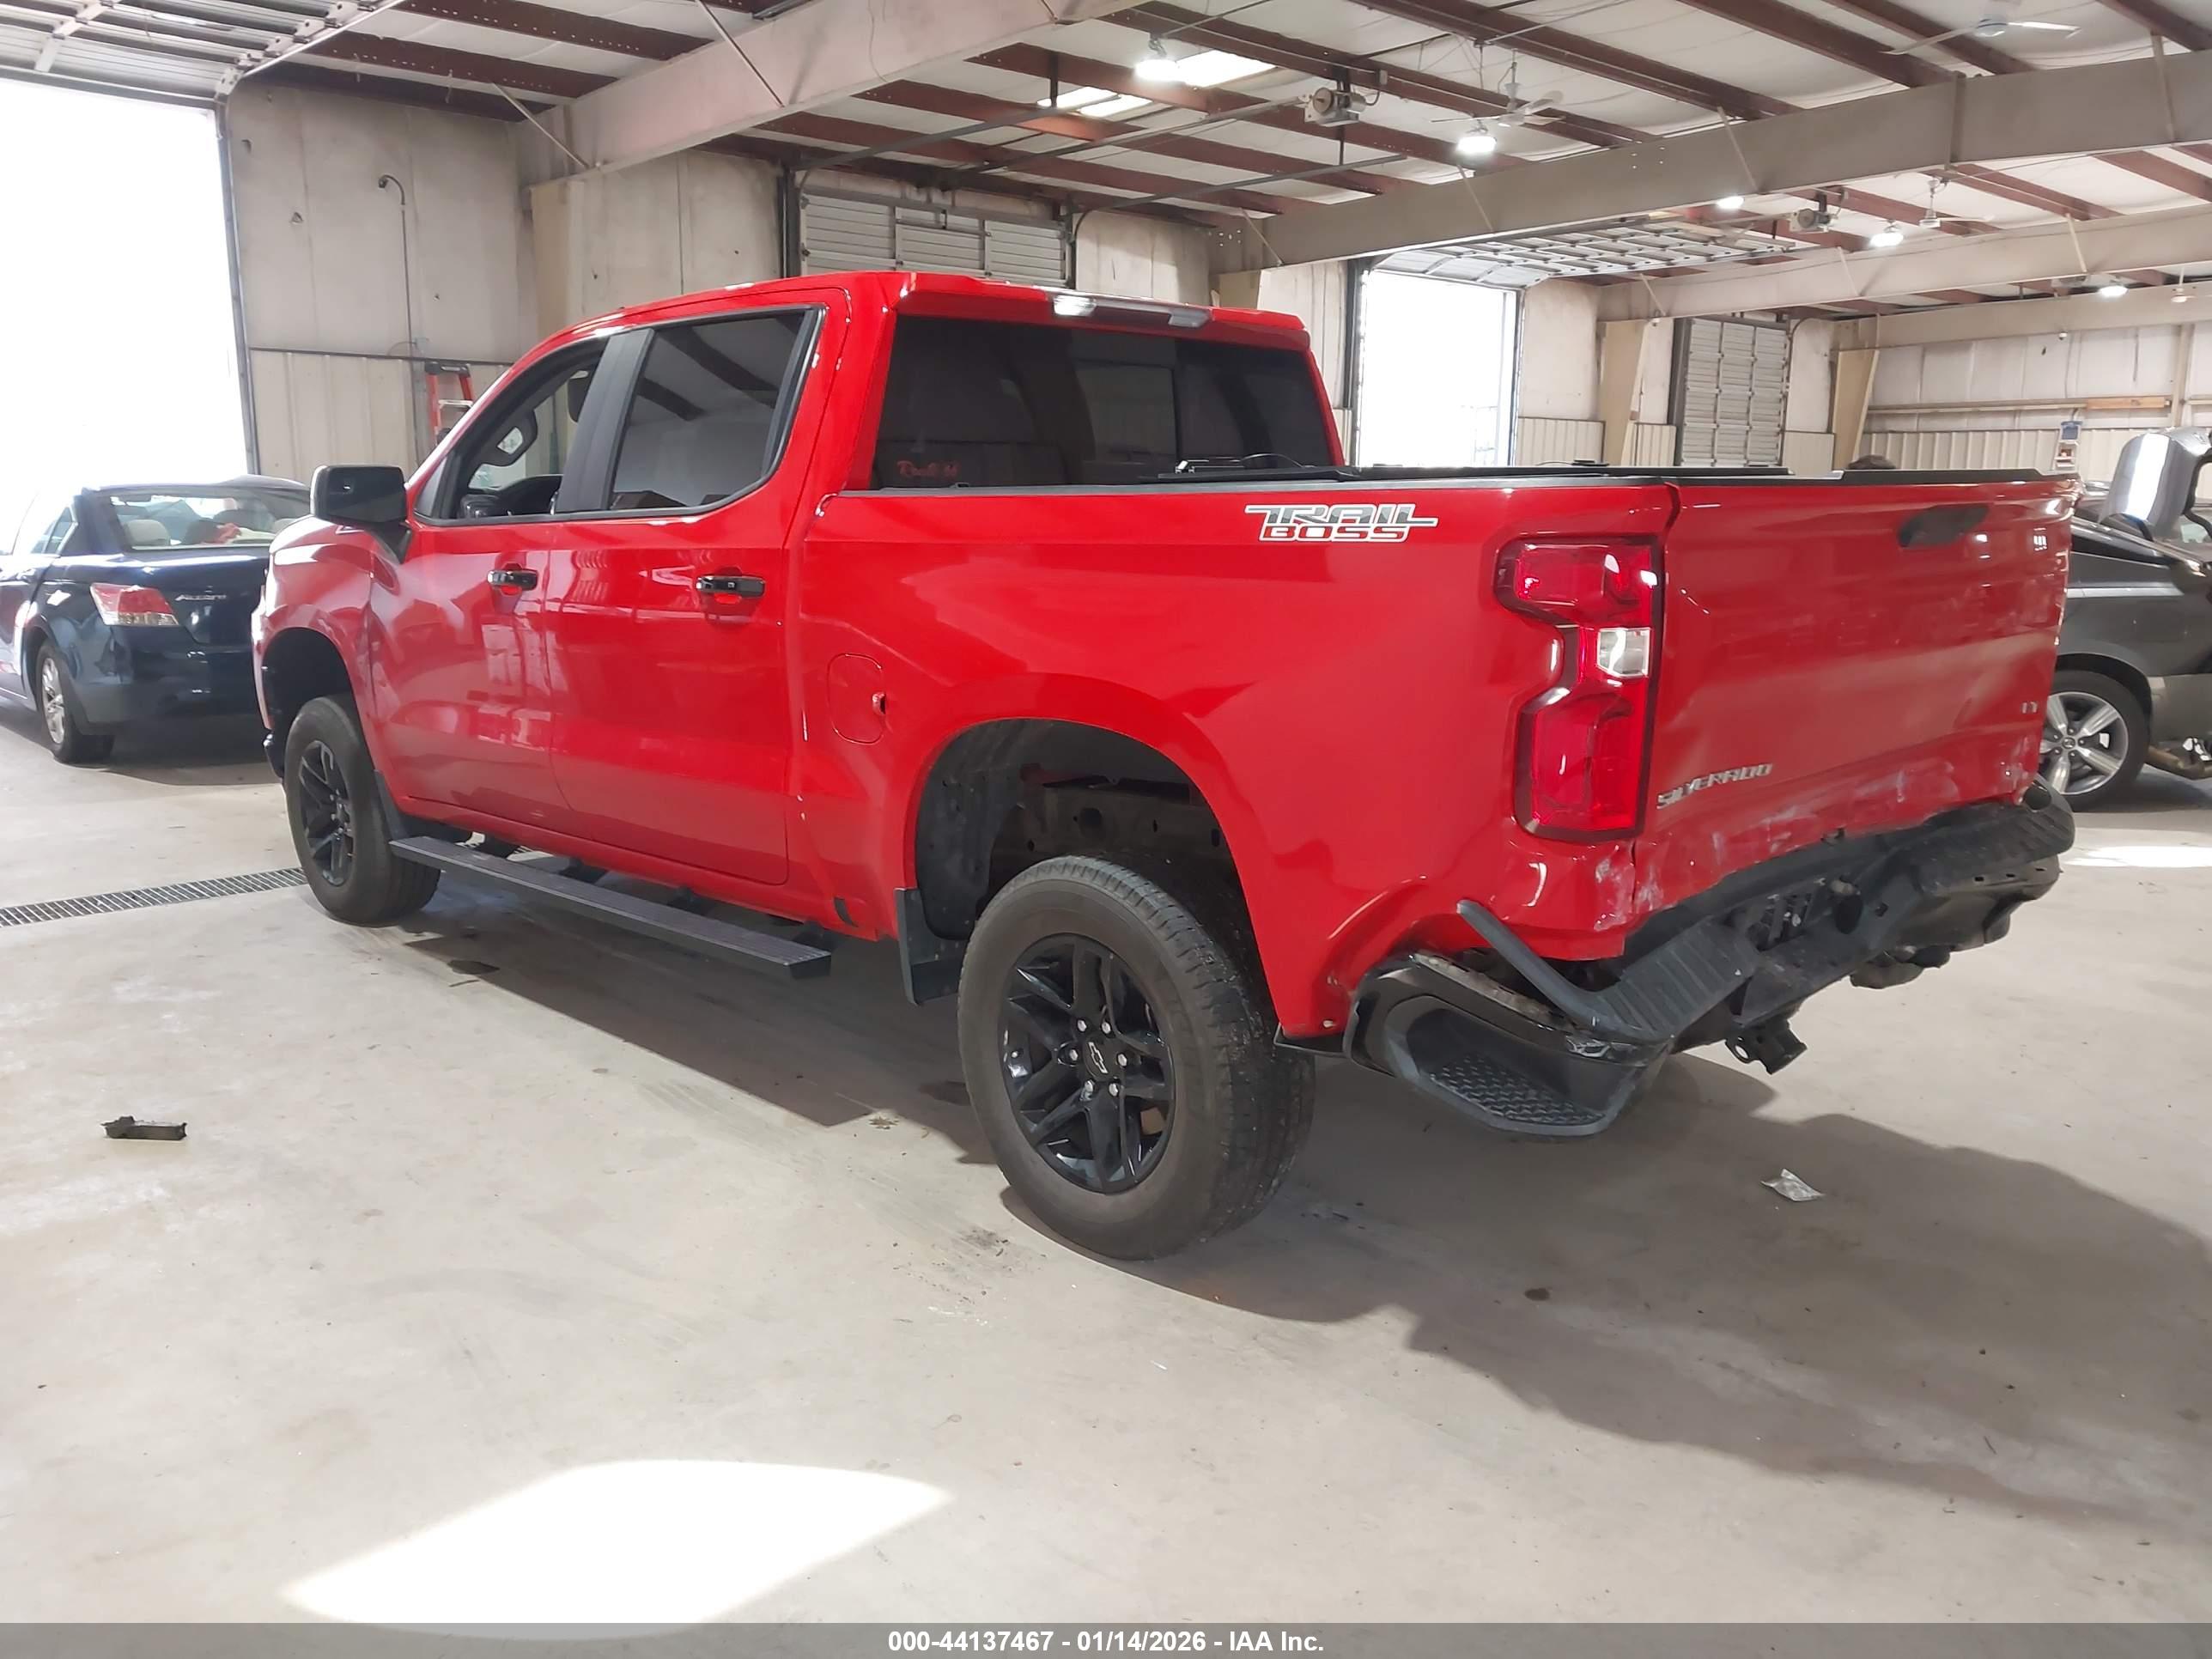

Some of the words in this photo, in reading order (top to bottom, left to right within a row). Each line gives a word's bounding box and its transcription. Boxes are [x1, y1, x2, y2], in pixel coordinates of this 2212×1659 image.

[1244, 504, 1439, 526] TRAIL
[1259, 524, 1410, 542] BOSS
[1656, 763, 1773, 810] SILVERADO
